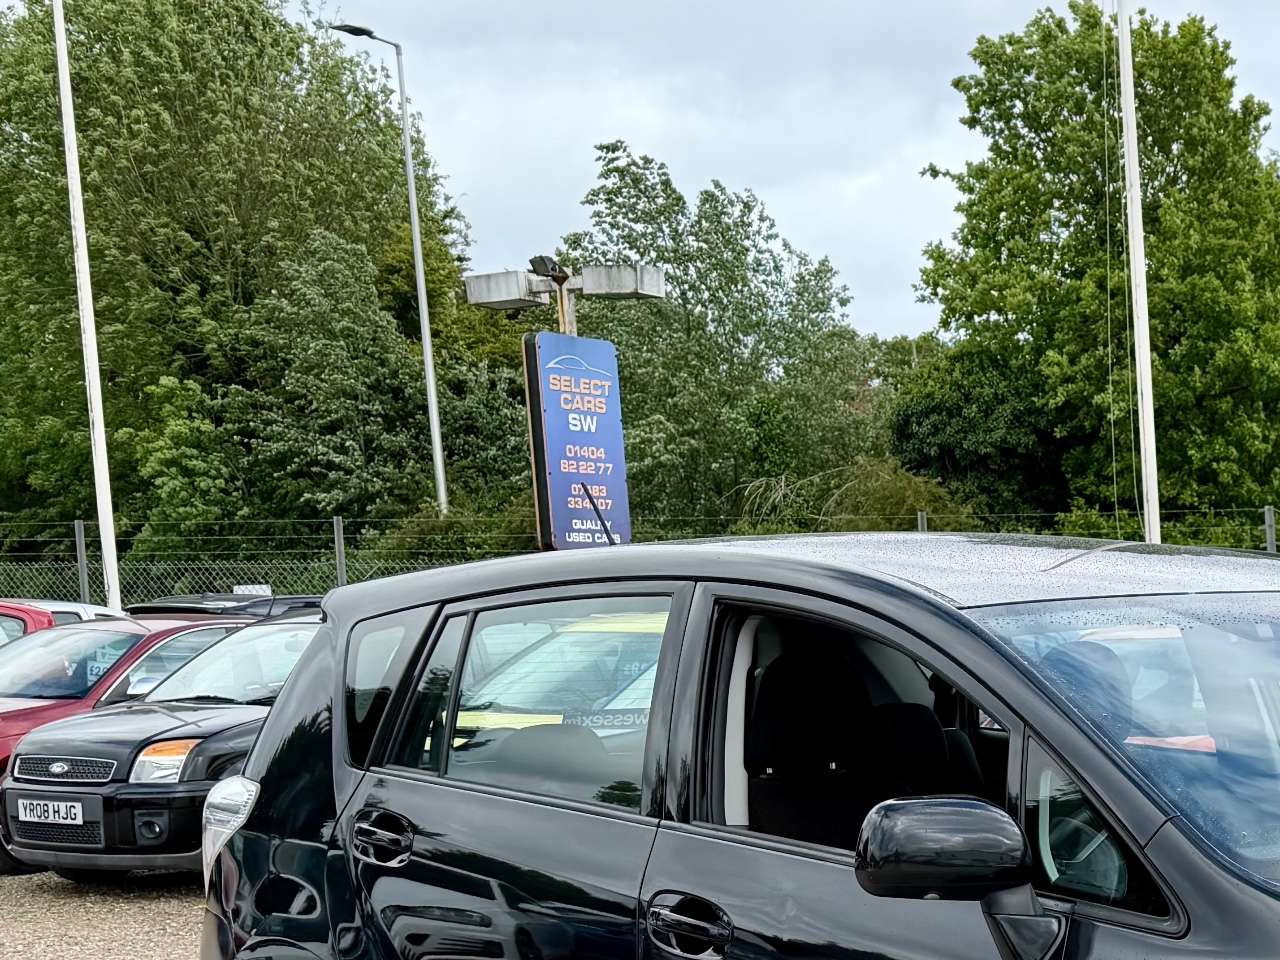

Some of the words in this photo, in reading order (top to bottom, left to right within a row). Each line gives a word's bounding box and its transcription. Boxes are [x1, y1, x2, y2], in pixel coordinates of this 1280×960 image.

[549, 374, 612, 396] SELECT
[560, 396, 607, 414] CARS
[568, 413, 597, 432] SW
[566, 445, 606, 460] 01404
[572, 519, 612, 530] QUALIY
[566, 532, 592, 543] USED
[594, 533, 620, 544] CAS
[22, 802, 50, 819] YR08
[53, 804, 77, 821] HJG
